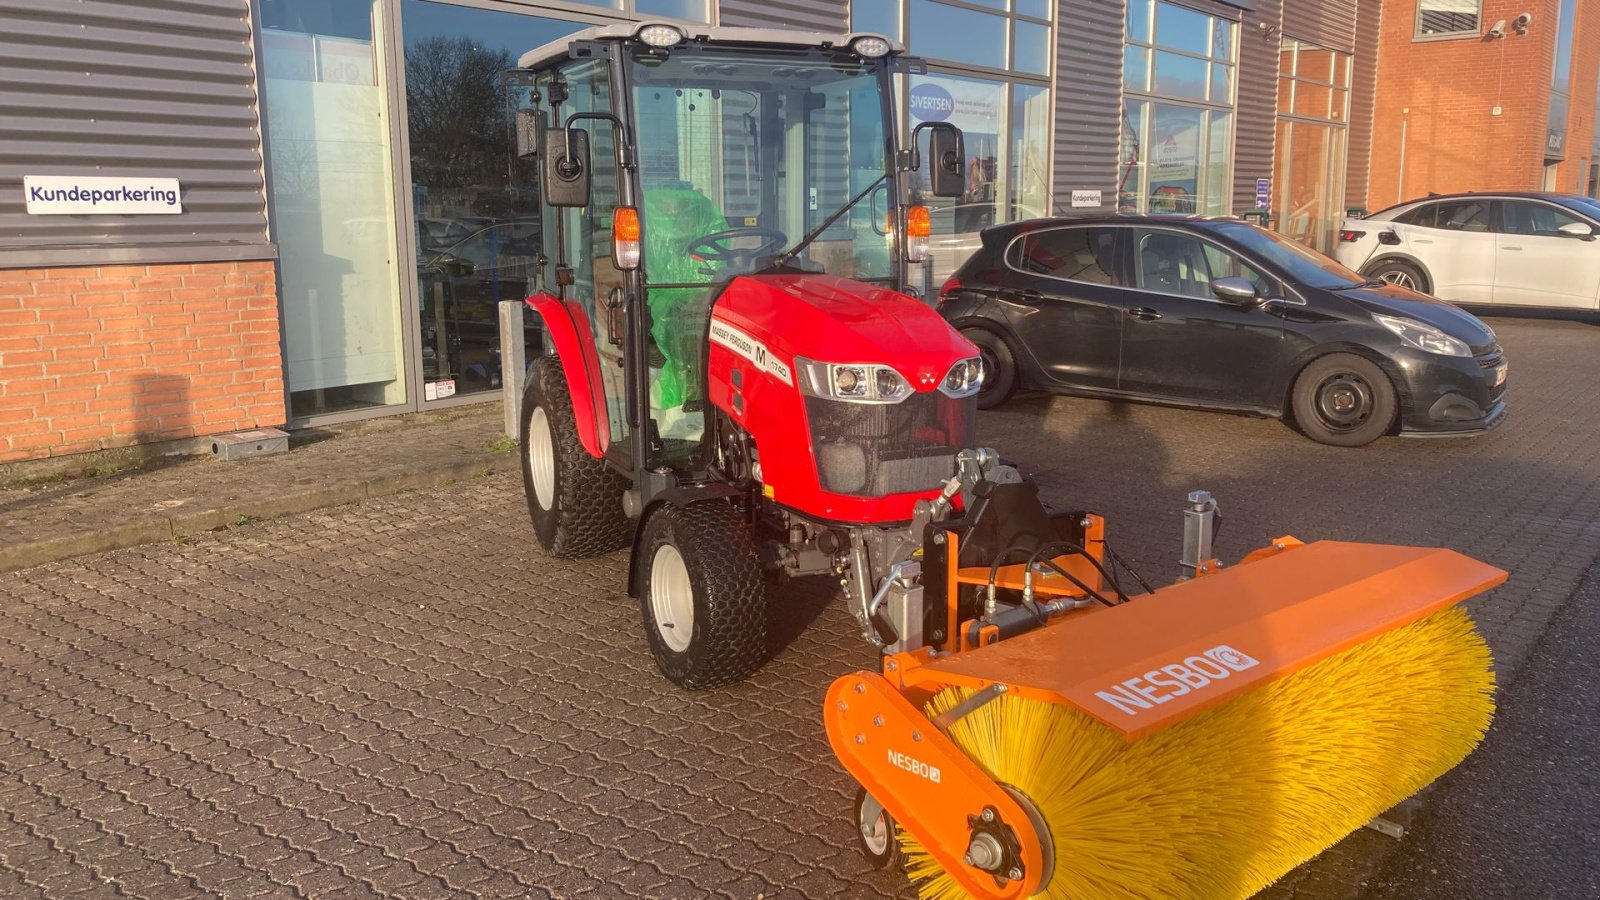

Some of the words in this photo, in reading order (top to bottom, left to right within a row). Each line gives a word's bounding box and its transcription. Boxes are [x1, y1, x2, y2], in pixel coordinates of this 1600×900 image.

[910, 95, 952, 112] SIVERTSEN
[30, 185, 176, 205] Kundeparkering
[712, 325, 729, 340] MASSEY
[730, 333, 752, 354] FERGUSON
[756, 345, 766, 366] M
[1093, 655, 1231, 716] NESBO
[887, 748, 929, 779] NESBO
